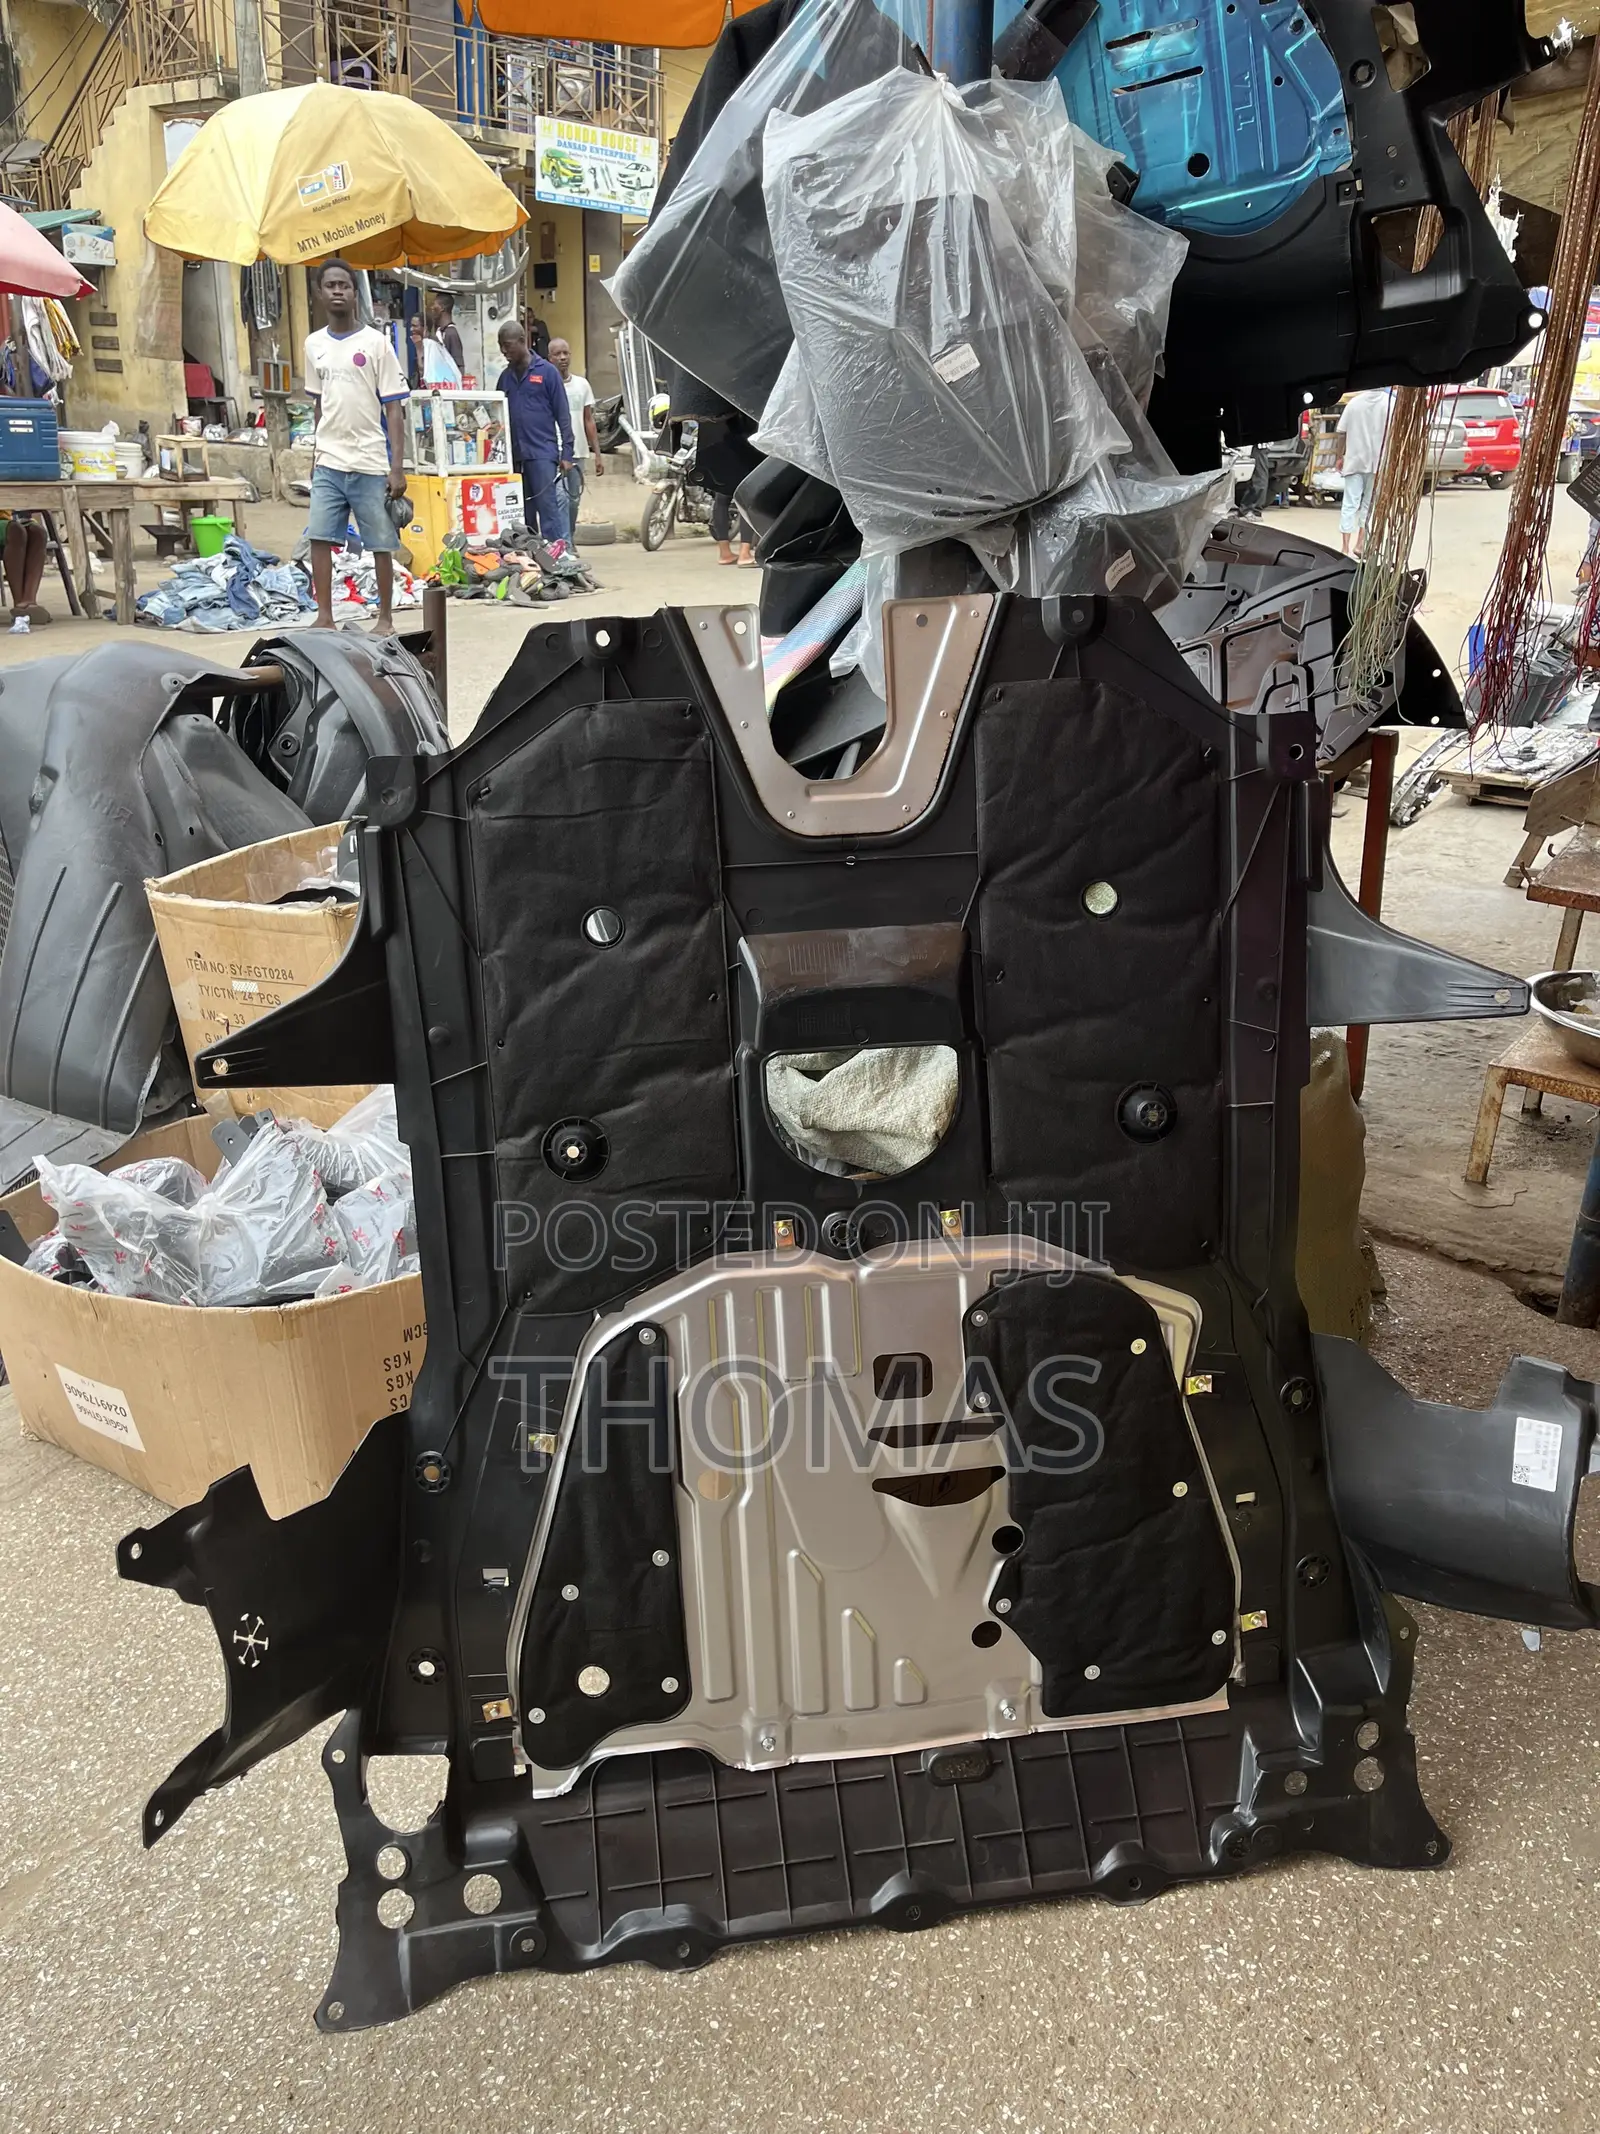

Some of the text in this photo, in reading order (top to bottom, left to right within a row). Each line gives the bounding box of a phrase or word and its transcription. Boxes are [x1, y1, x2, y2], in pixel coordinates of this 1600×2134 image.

[557, 122, 639, 154] HONDA HOUSE
[589, 146, 637, 162] ENTERPRISE
[304, 182, 320, 194] MTN
[312, 195, 351, 213] Mobile Money
[296, 212, 387, 253] MTN Mobile Money
[186, 957, 209, 972] ITEM
[229, 963, 294, 980] SY-FGT0284
[198, 984, 239, 1001] TY/CTN:
[259, 992, 282, 1006] PCS
[233, 1013, 246, 1025] 33
[383, 1350, 412, 1372] KGS
[386, 1370, 414, 1392] KGS
[64, 1382, 128, 1418] 0249179406
[390, 1394, 408, 1412] CS
